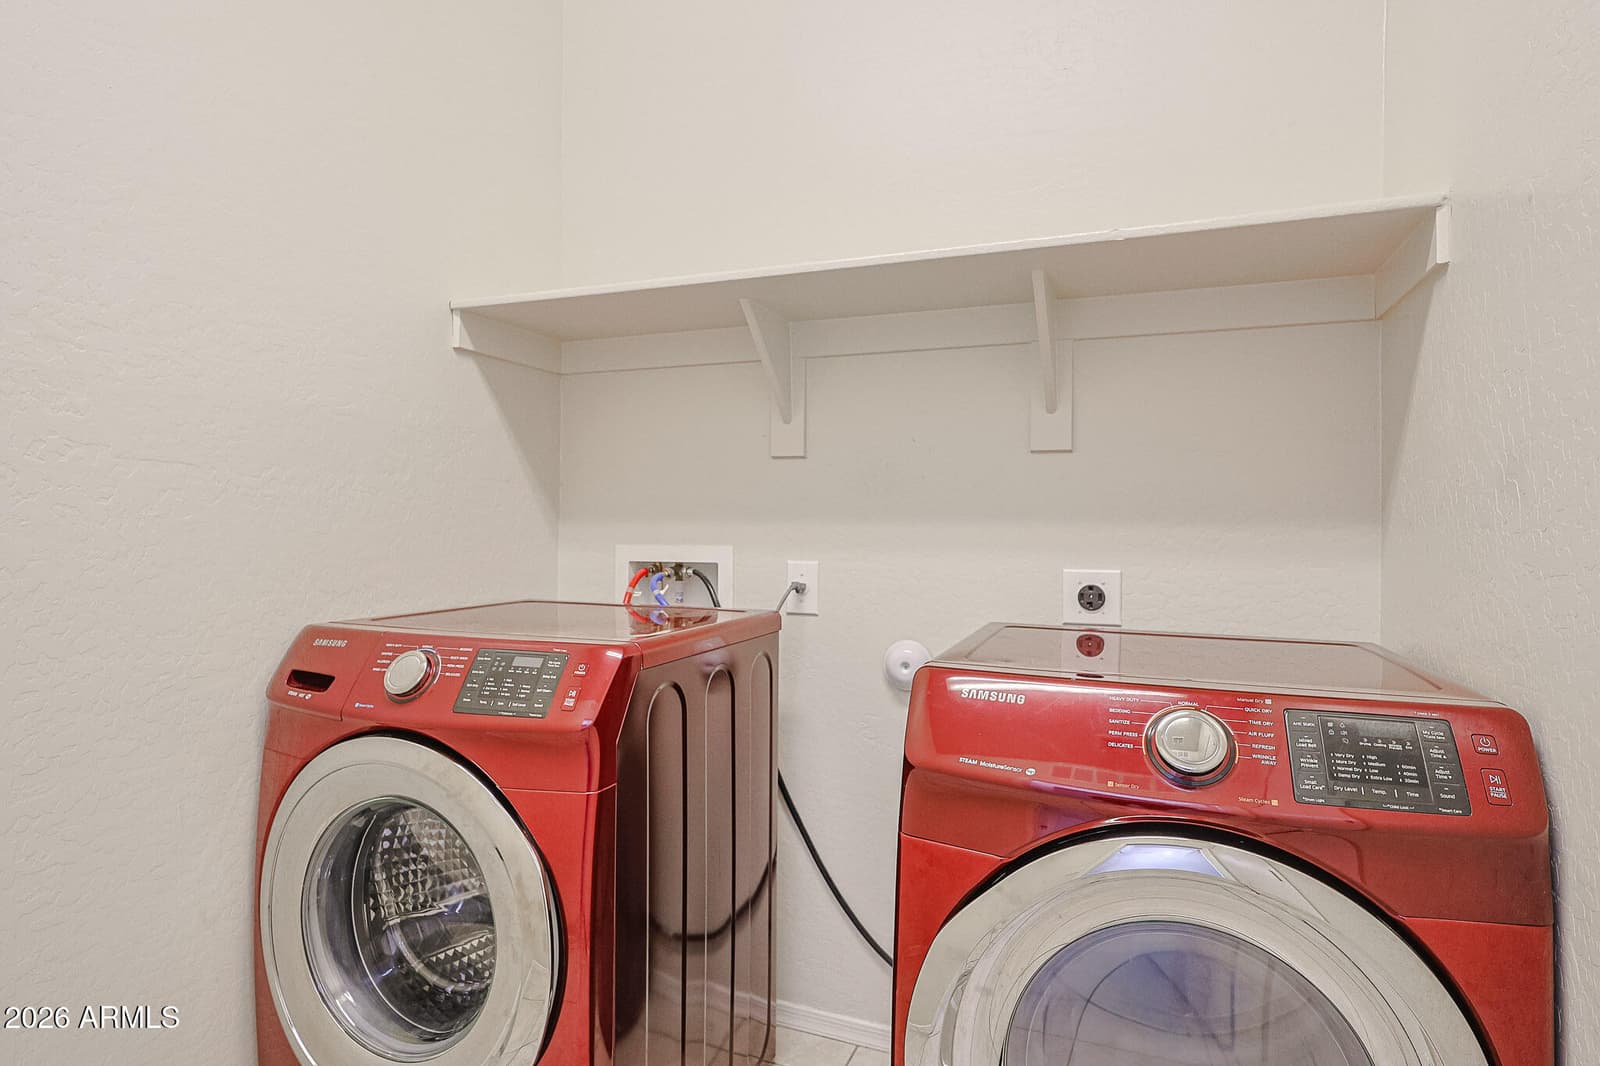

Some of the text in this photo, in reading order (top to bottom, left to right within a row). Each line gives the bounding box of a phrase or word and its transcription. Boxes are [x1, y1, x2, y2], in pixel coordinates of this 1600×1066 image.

[313, 638, 348, 648] SAMSUNG
[961, 688, 1026, 705] SAMSUNG
[959, 757, 978, 765] STEAM
